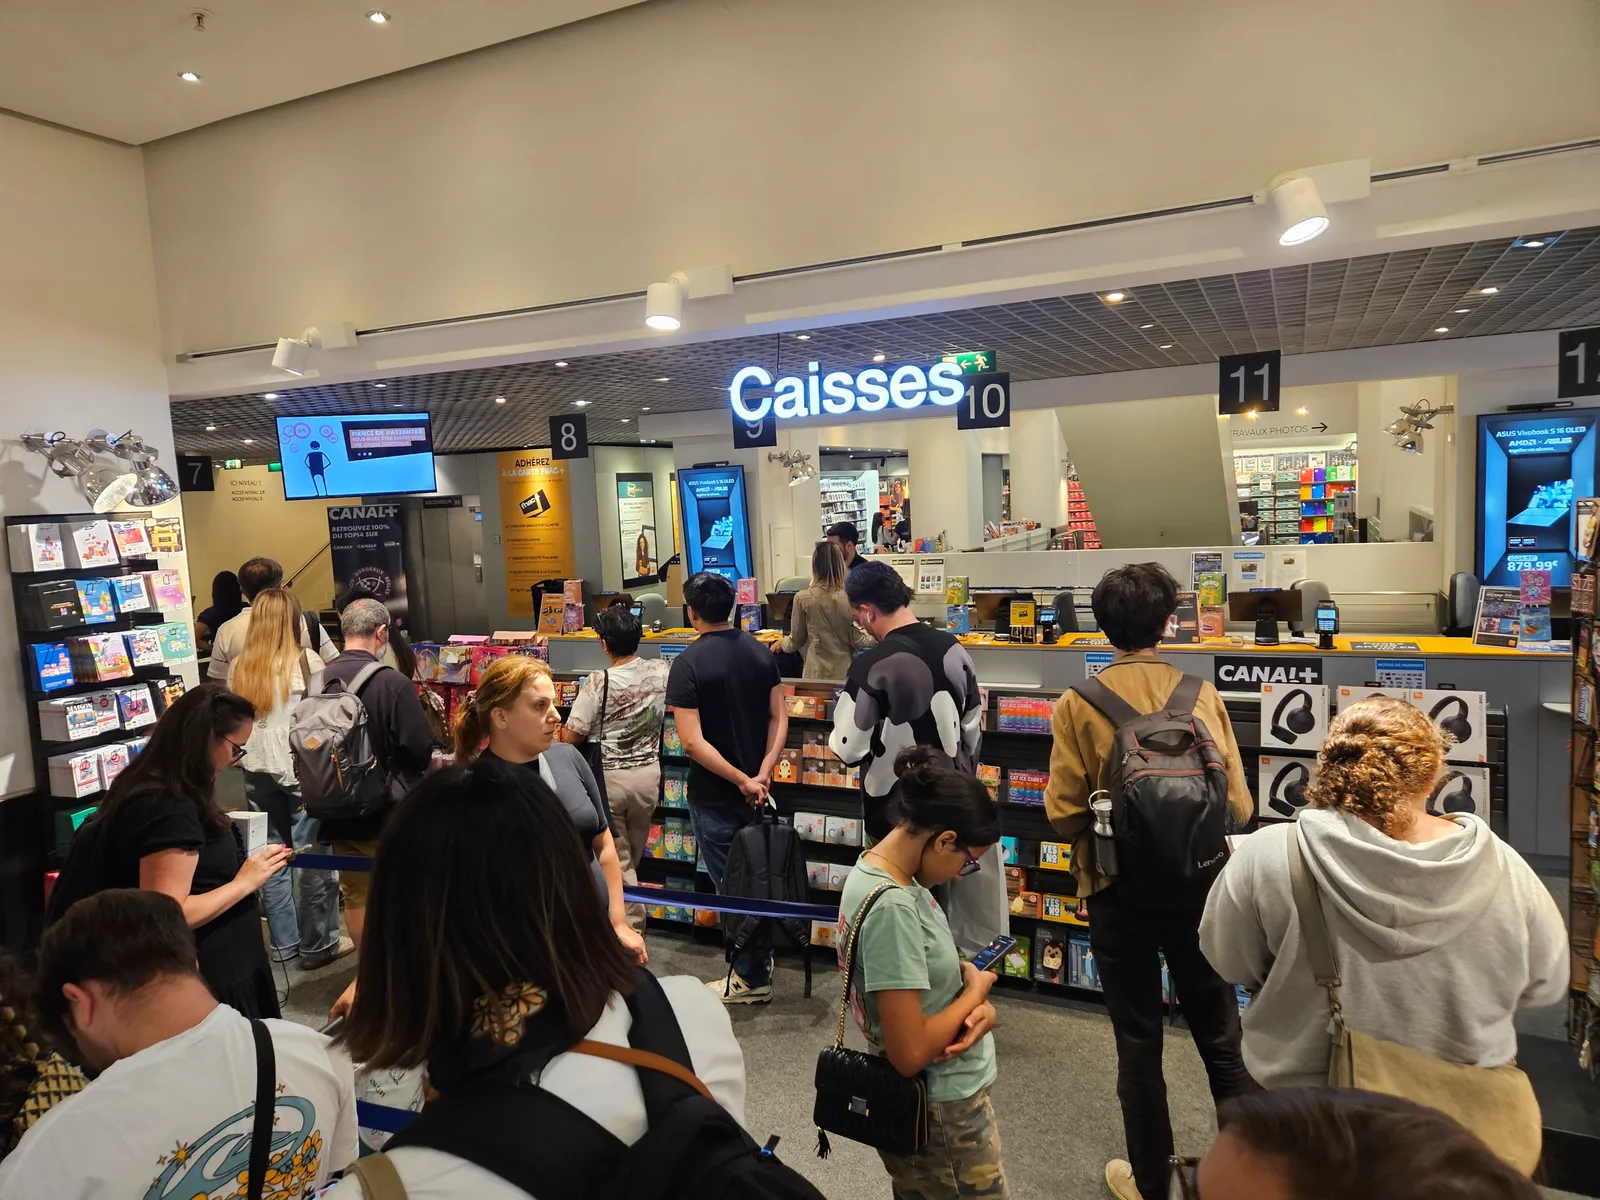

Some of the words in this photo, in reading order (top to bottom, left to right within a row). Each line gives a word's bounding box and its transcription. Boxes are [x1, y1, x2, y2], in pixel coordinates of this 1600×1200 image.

[1566, 342, 1600, 384] 1
[1230, 363, 1269, 402] 11
[730, 361, 965, 421] Caisses
[965, 383, 1006, 420] 10
[560, 422, 577, 452] 8
[1270, 425, 1308, 435] PHOTOS
[515, 456, 550, 467] ADHÉREZ
[188, 462, 202, 484] 7
[328, 505, 398, 520] CANAL+
[355, 566, 385, 577] BORDEAUX
[1571, 578, 1593, 591] SIZE
[66, 702, 93, 711] MAISON
[1043, 843, 1058, 855] YES
[1045, 898, 1060, 909] YES
